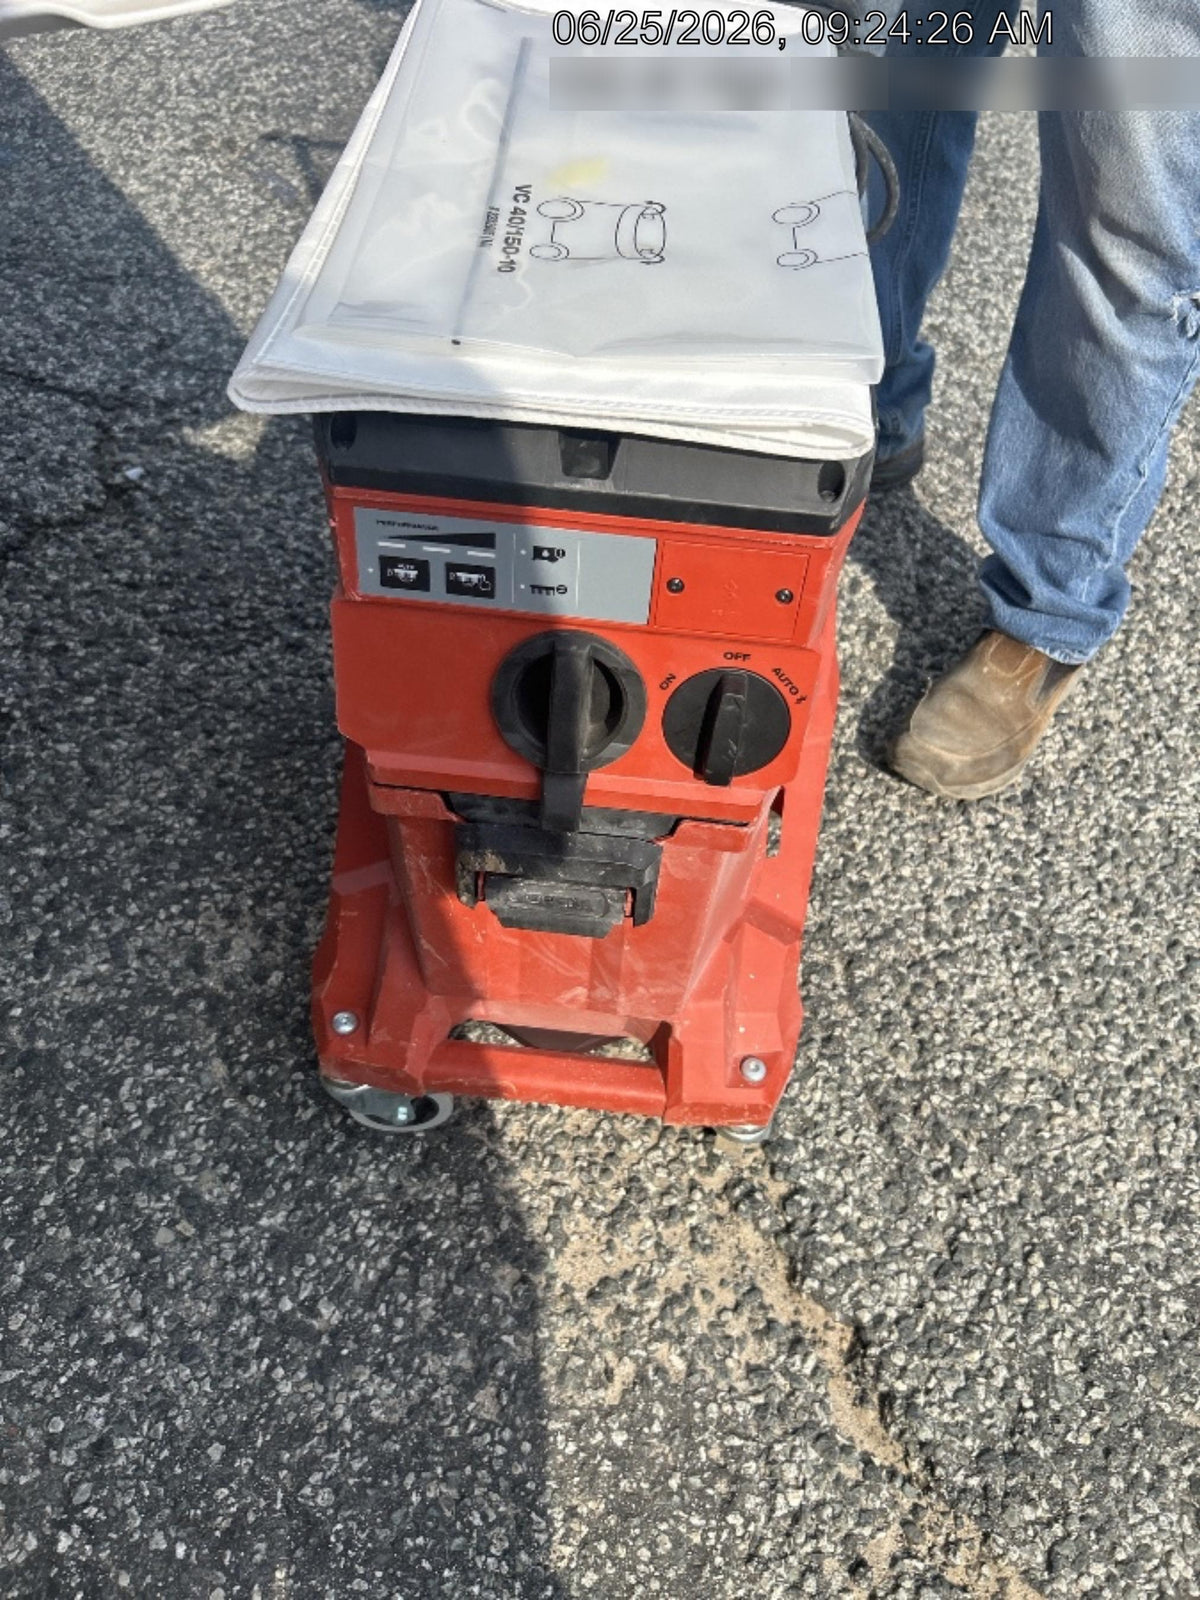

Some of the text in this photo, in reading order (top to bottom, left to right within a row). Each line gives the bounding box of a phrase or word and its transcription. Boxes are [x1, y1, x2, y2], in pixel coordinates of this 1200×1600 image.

[497, 184, 533, 273] VC 40/150-10
[723, 651, 752, 662] OFF
[659, 673, 676, 691] ON
[771, 667, 800, 697] AUTO
